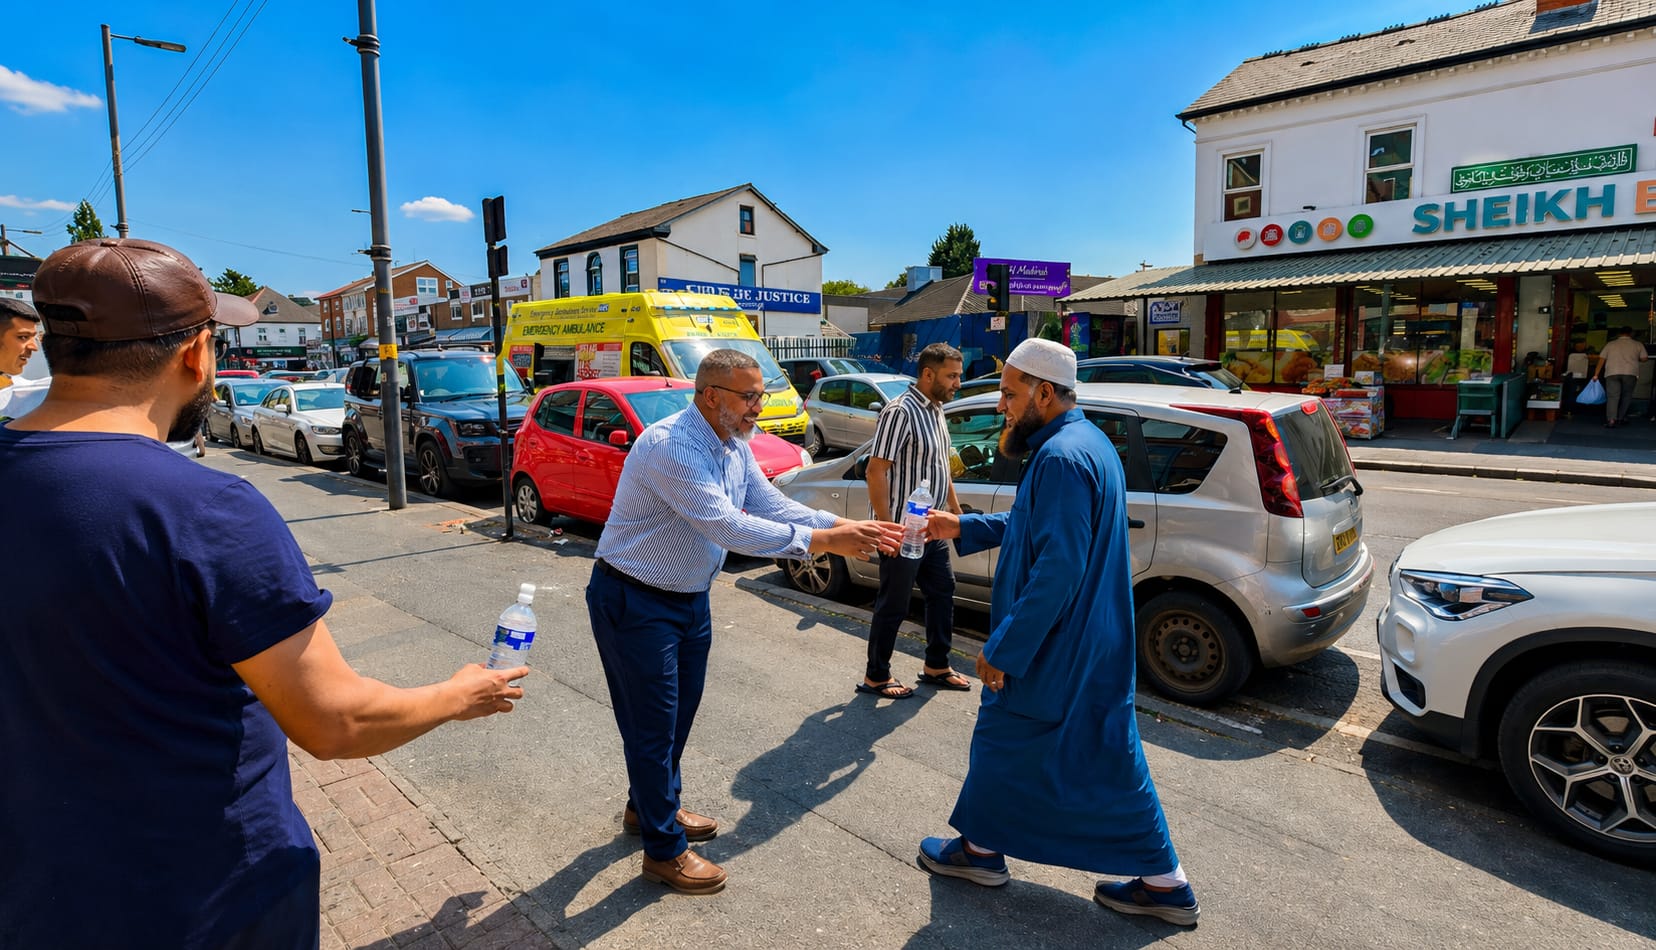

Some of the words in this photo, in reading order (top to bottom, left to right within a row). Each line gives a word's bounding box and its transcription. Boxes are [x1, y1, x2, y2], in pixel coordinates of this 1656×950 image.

[1412, 184, 1616, 235] SHEIKH
[755, 290, 811, 304] JUSTICE
[522, 323, 561, 337] EMERGENCY
[561, 322, 606, 335] AMBULANCE
